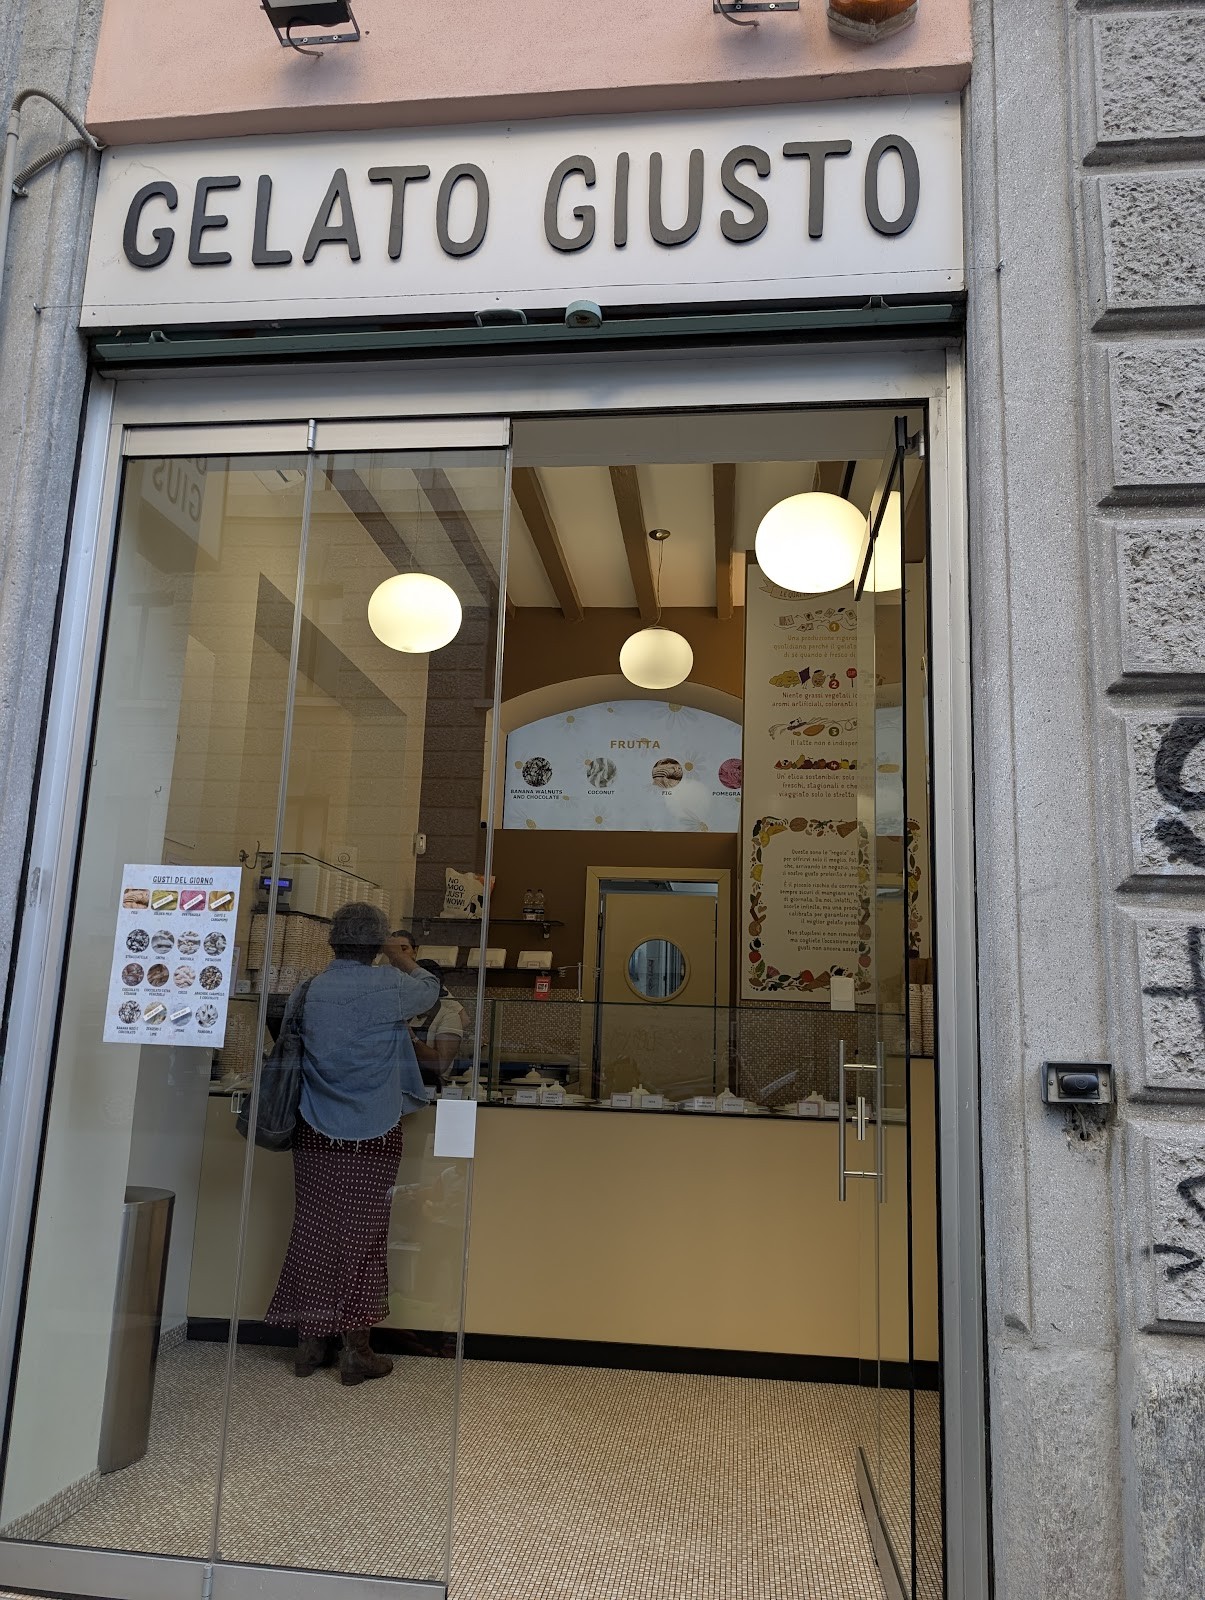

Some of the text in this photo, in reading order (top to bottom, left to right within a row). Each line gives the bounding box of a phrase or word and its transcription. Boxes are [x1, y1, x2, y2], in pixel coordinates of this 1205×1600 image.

[122, 133, 921, 268] GELATO GIUSTO
[610, 740, 661, 749] FRUTTA
[446, 898, 465, 906] WOW!
